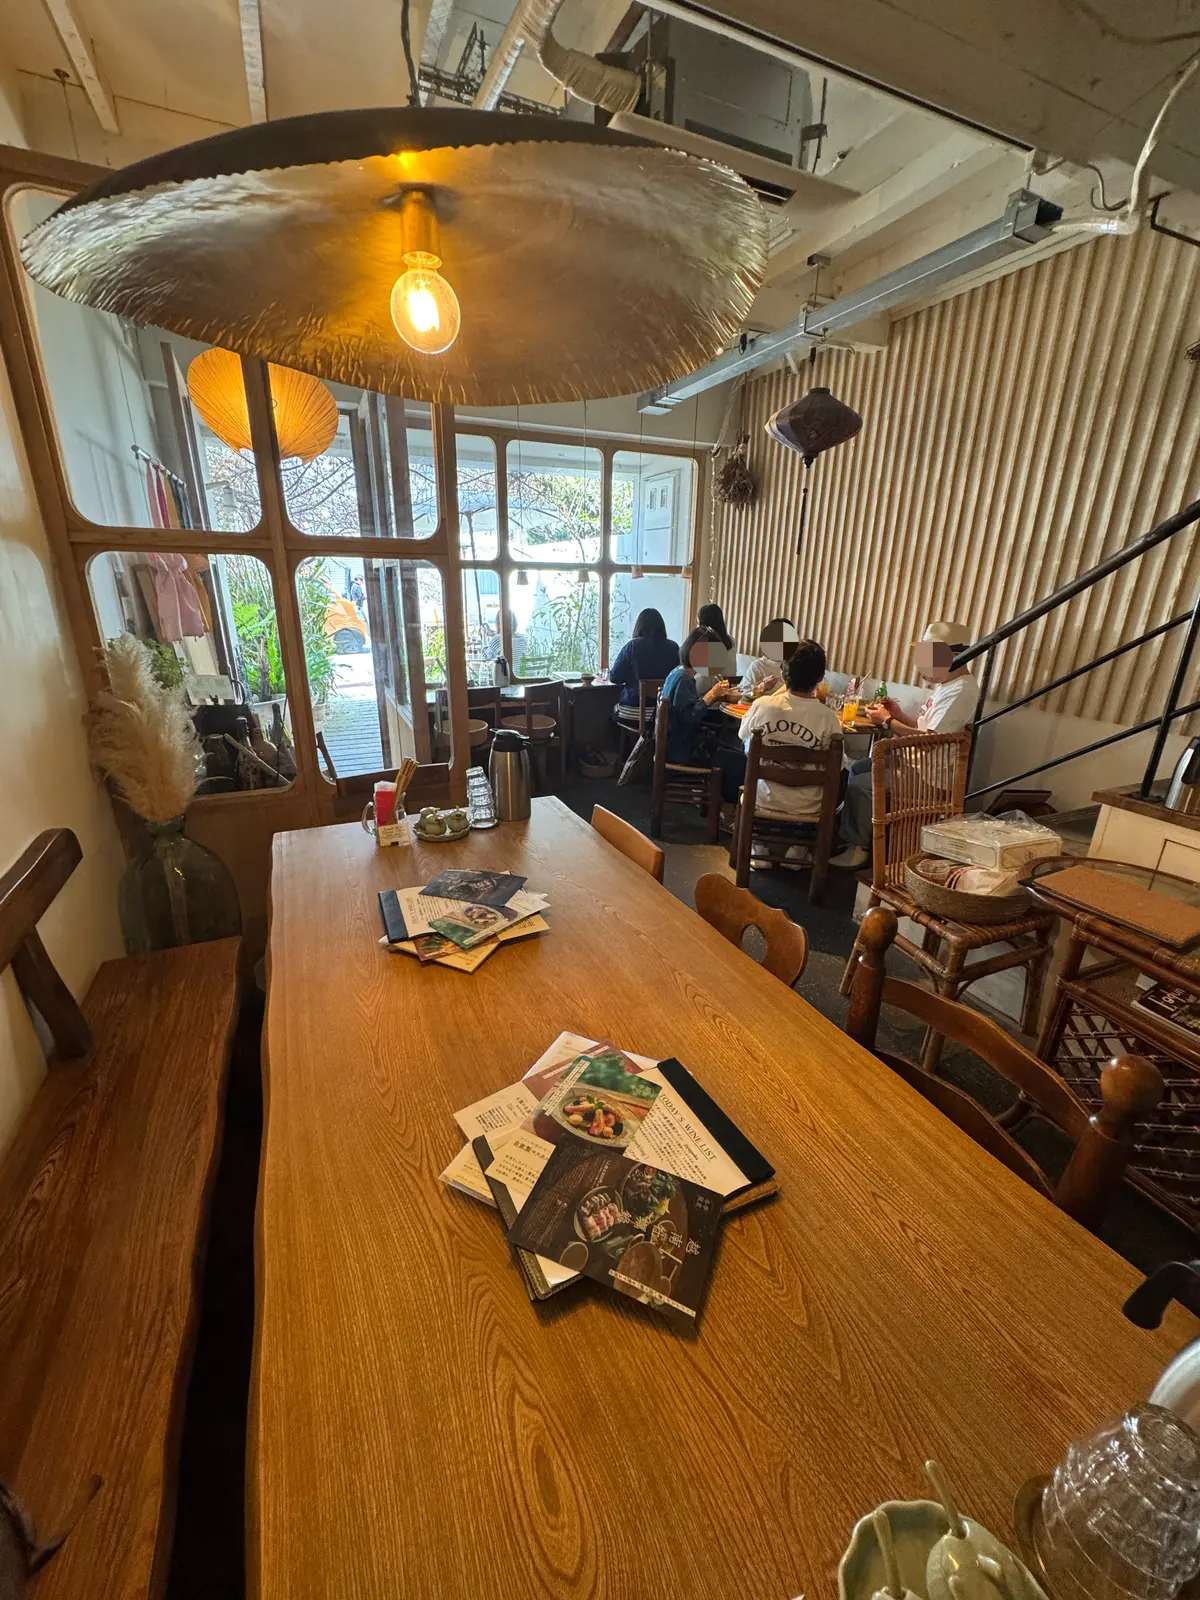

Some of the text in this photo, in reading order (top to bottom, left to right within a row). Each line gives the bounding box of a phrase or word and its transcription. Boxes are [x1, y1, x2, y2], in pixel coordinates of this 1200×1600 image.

[660, 1093, 685, 1123] TODAY'S
[684, 1123, 702, 1144] WINE
[700, 1143, 717, 1161] LIST
